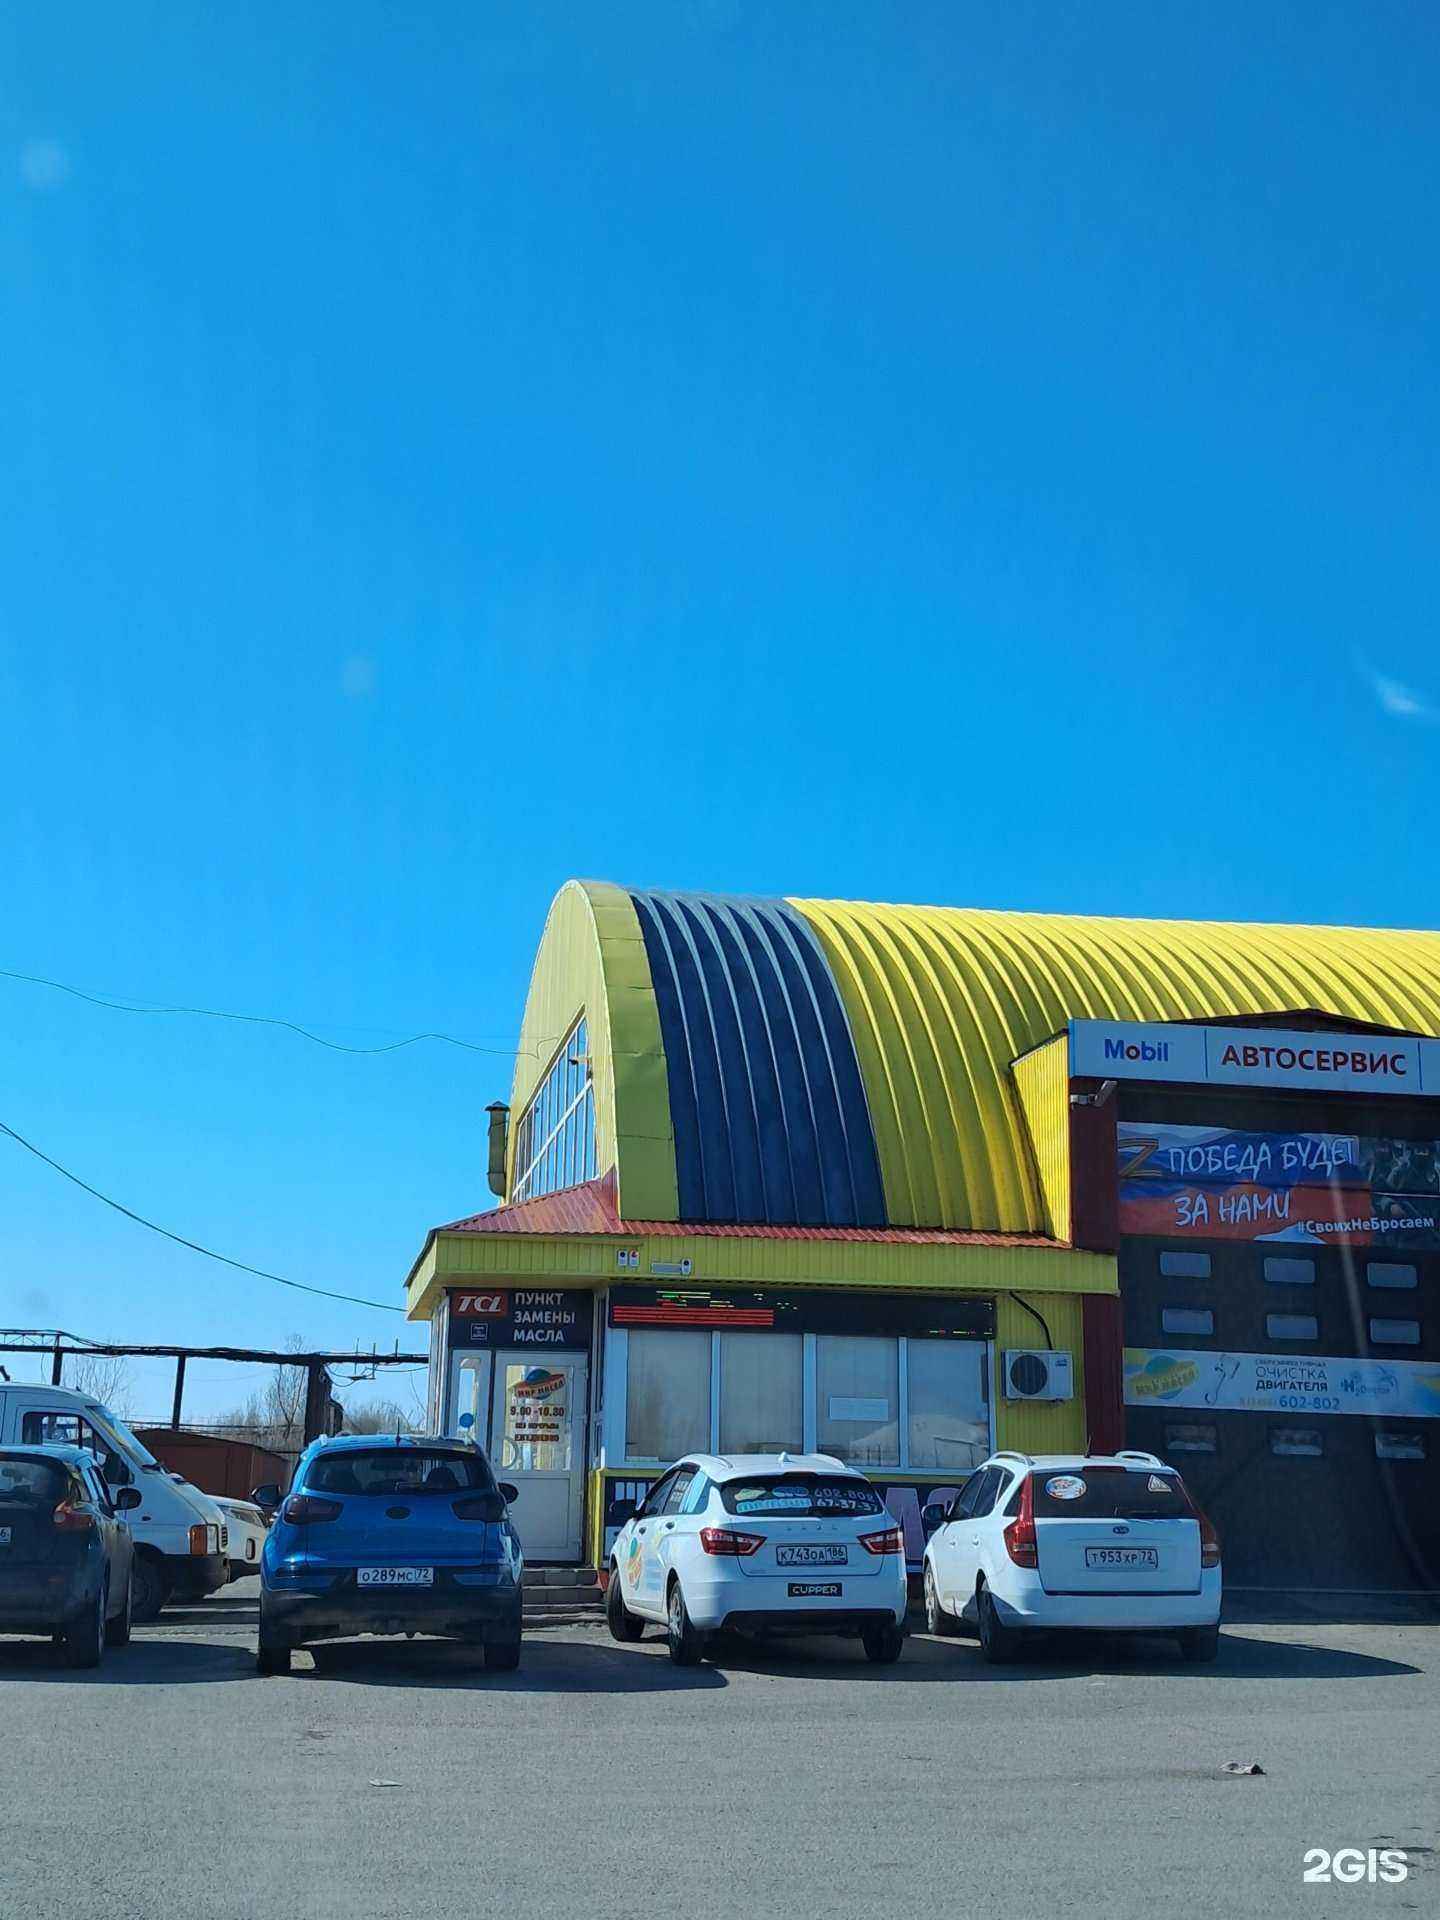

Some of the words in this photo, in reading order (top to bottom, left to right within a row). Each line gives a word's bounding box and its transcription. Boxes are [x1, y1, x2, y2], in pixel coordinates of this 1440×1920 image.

[1104, 1038, 1169, 1062] Mobil
[1221, 1044, 1407, 1076] АВТОСЕРВИС
[1168, 1142, 1272, 1180] ПОБЕДА
[1281, 1137, 1359, 1176] БУДЕТ
[1174, 1194, 1210, 1227] ЗА
[1218, 1192, 1291, 1223] НАМИ
[1298, 1217, 1434, 1235] #СвоихНеБросаем
[458, 1295, 502, 1313] TCL
[514, 1291, 564, 1305] ПУНКТ
[513, 1310, 576, 1324] ЗАМЕНЫ
[513, 1329, 565, 1342] МАСЛА
[1255, 1366, 1328, 1381] ОЧИСТКА
[1255, 1380, 1328, 1392] ДВИГАТЕЛЯ
[1279, 1395, 1341, 1410] 602-802
